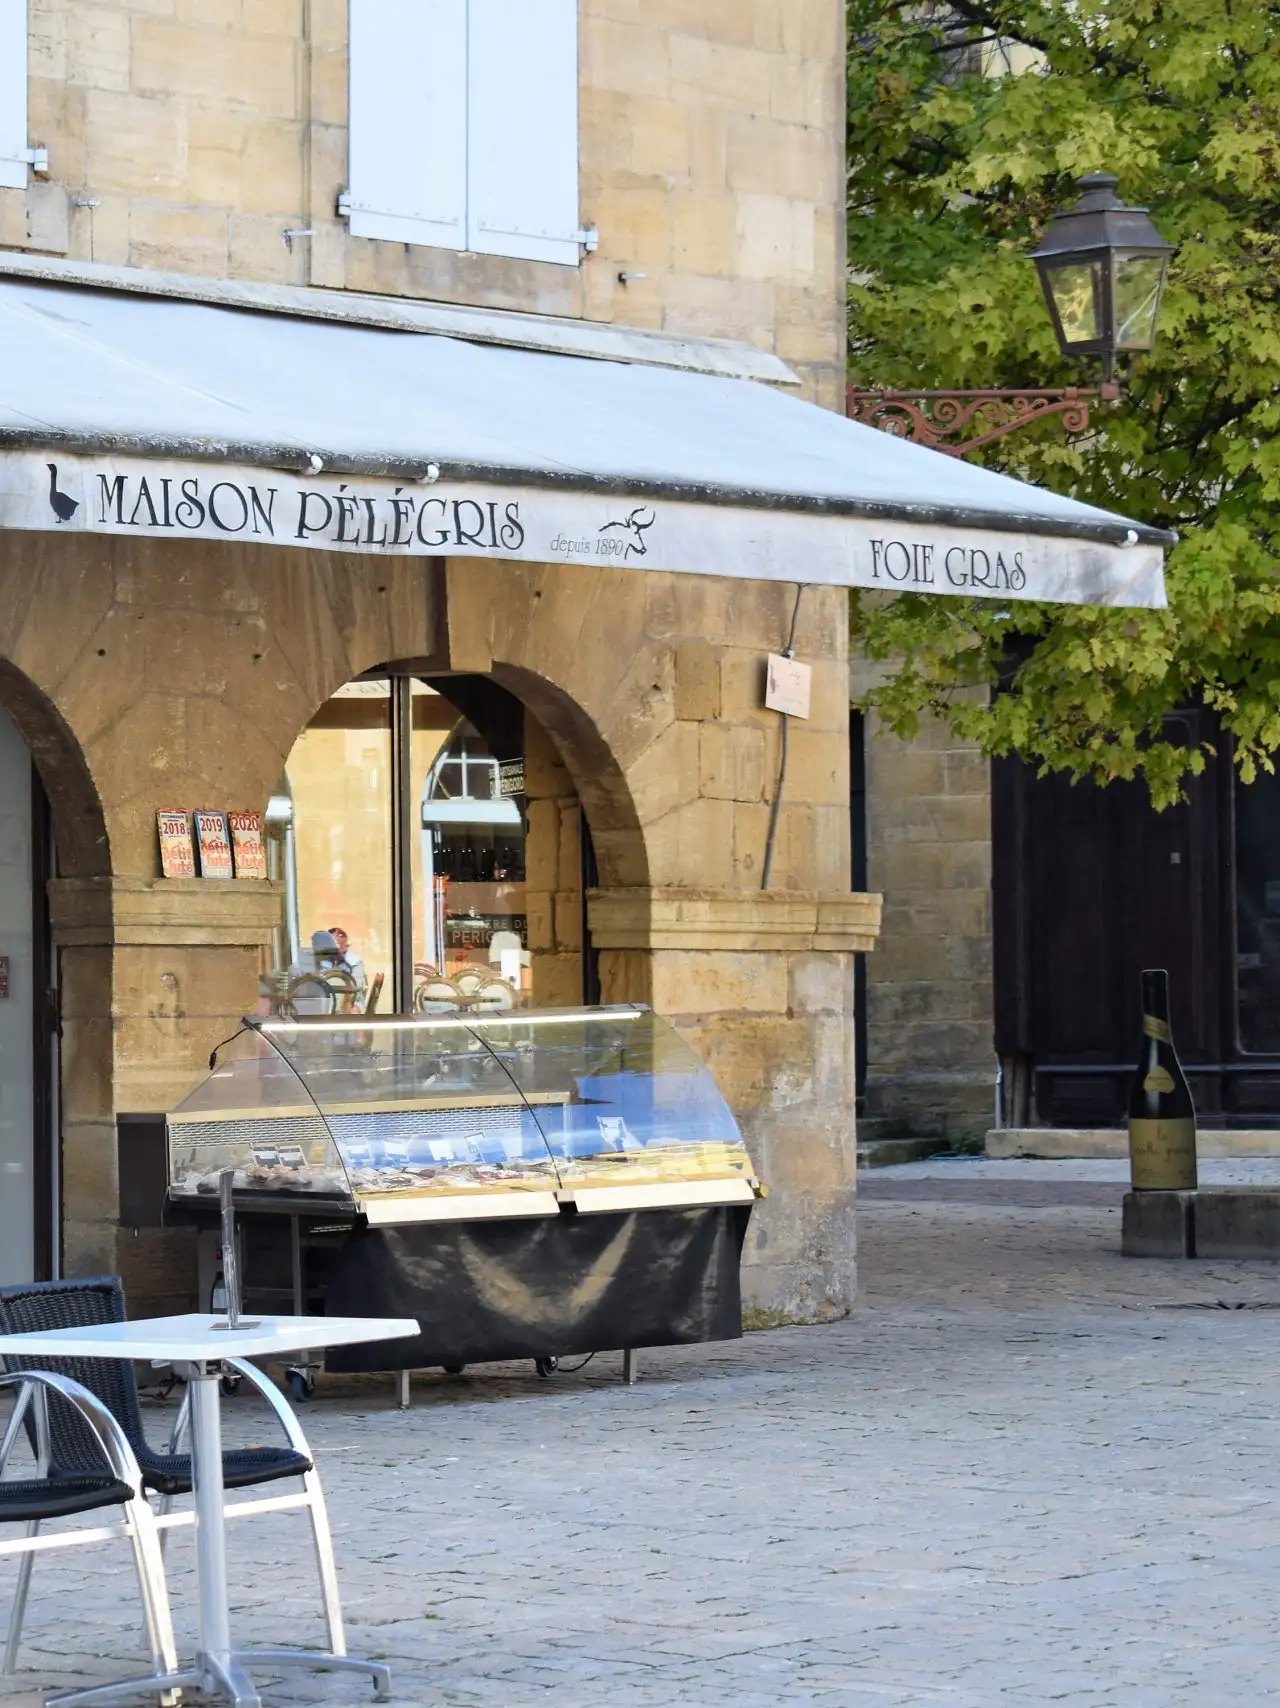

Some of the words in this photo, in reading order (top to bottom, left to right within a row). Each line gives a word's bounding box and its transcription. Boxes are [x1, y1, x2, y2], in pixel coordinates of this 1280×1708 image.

[97, 474, 277, 536] MAISON
[294, 484, 524, 550] PÉLÉGRIS
[550, 534, 590, 558] depuis
[595, 539, 624, 555] 1890
[869, 539, 934, 584] FOIE
[945, 547, 1026, 591] GRAS
[163, 822, 186, 835] 2018
[200, 818, 223, 832] 2019
[232, 815, 260, 831] 2020
